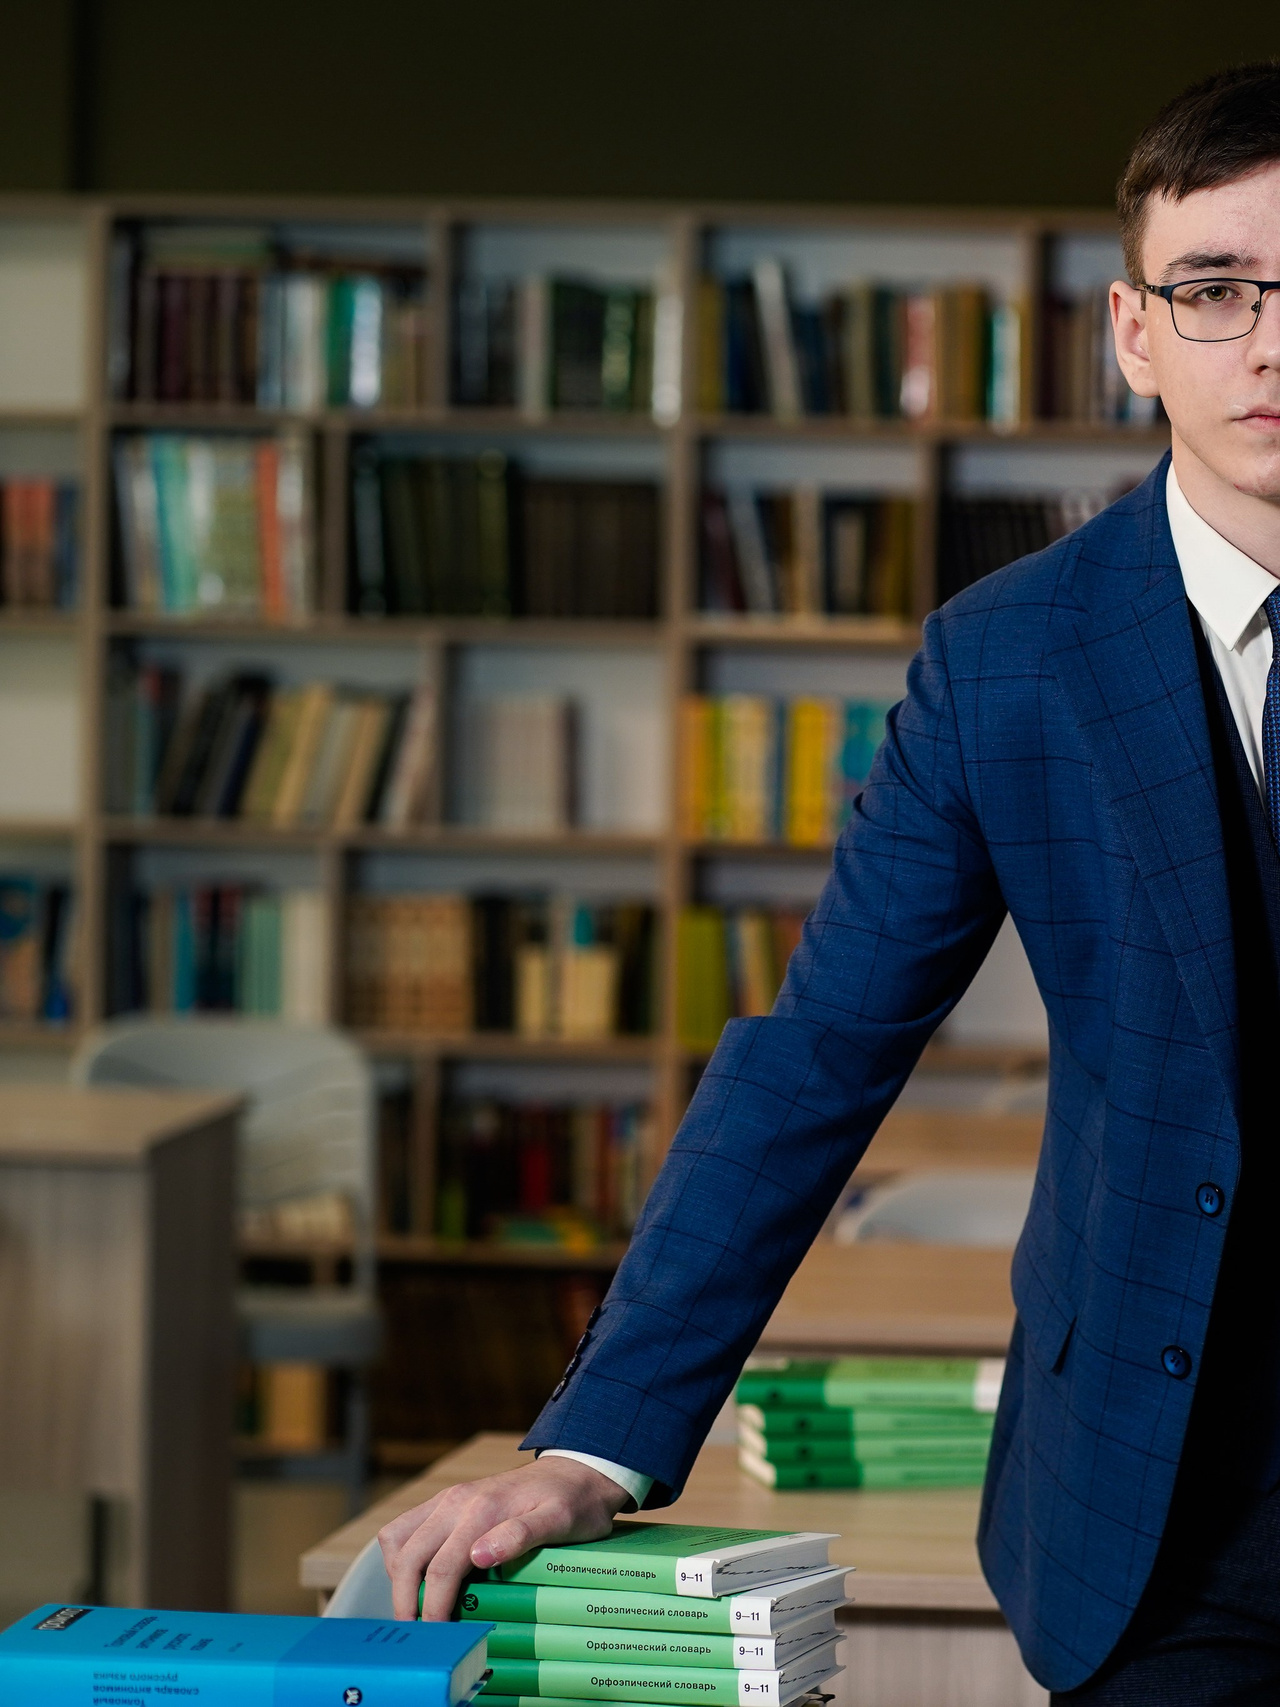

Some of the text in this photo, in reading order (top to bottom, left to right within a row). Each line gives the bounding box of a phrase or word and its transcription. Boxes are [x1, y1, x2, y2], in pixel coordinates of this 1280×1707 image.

[546, 1562, 657, 1580] Орфоэпический словарь
[586, 1604, 708, 1620] Орфоэпический словарь
[586, 1640, 711, 1655] Орфоэпический словарь
[129, 1672, 178, 1682] русского
[590, 1676, 716, 1692] Орфоэпический словарь
[93, 1685, 199, 1695] словарь антонимов
[93, 1697, 146, 1707] Толковый
